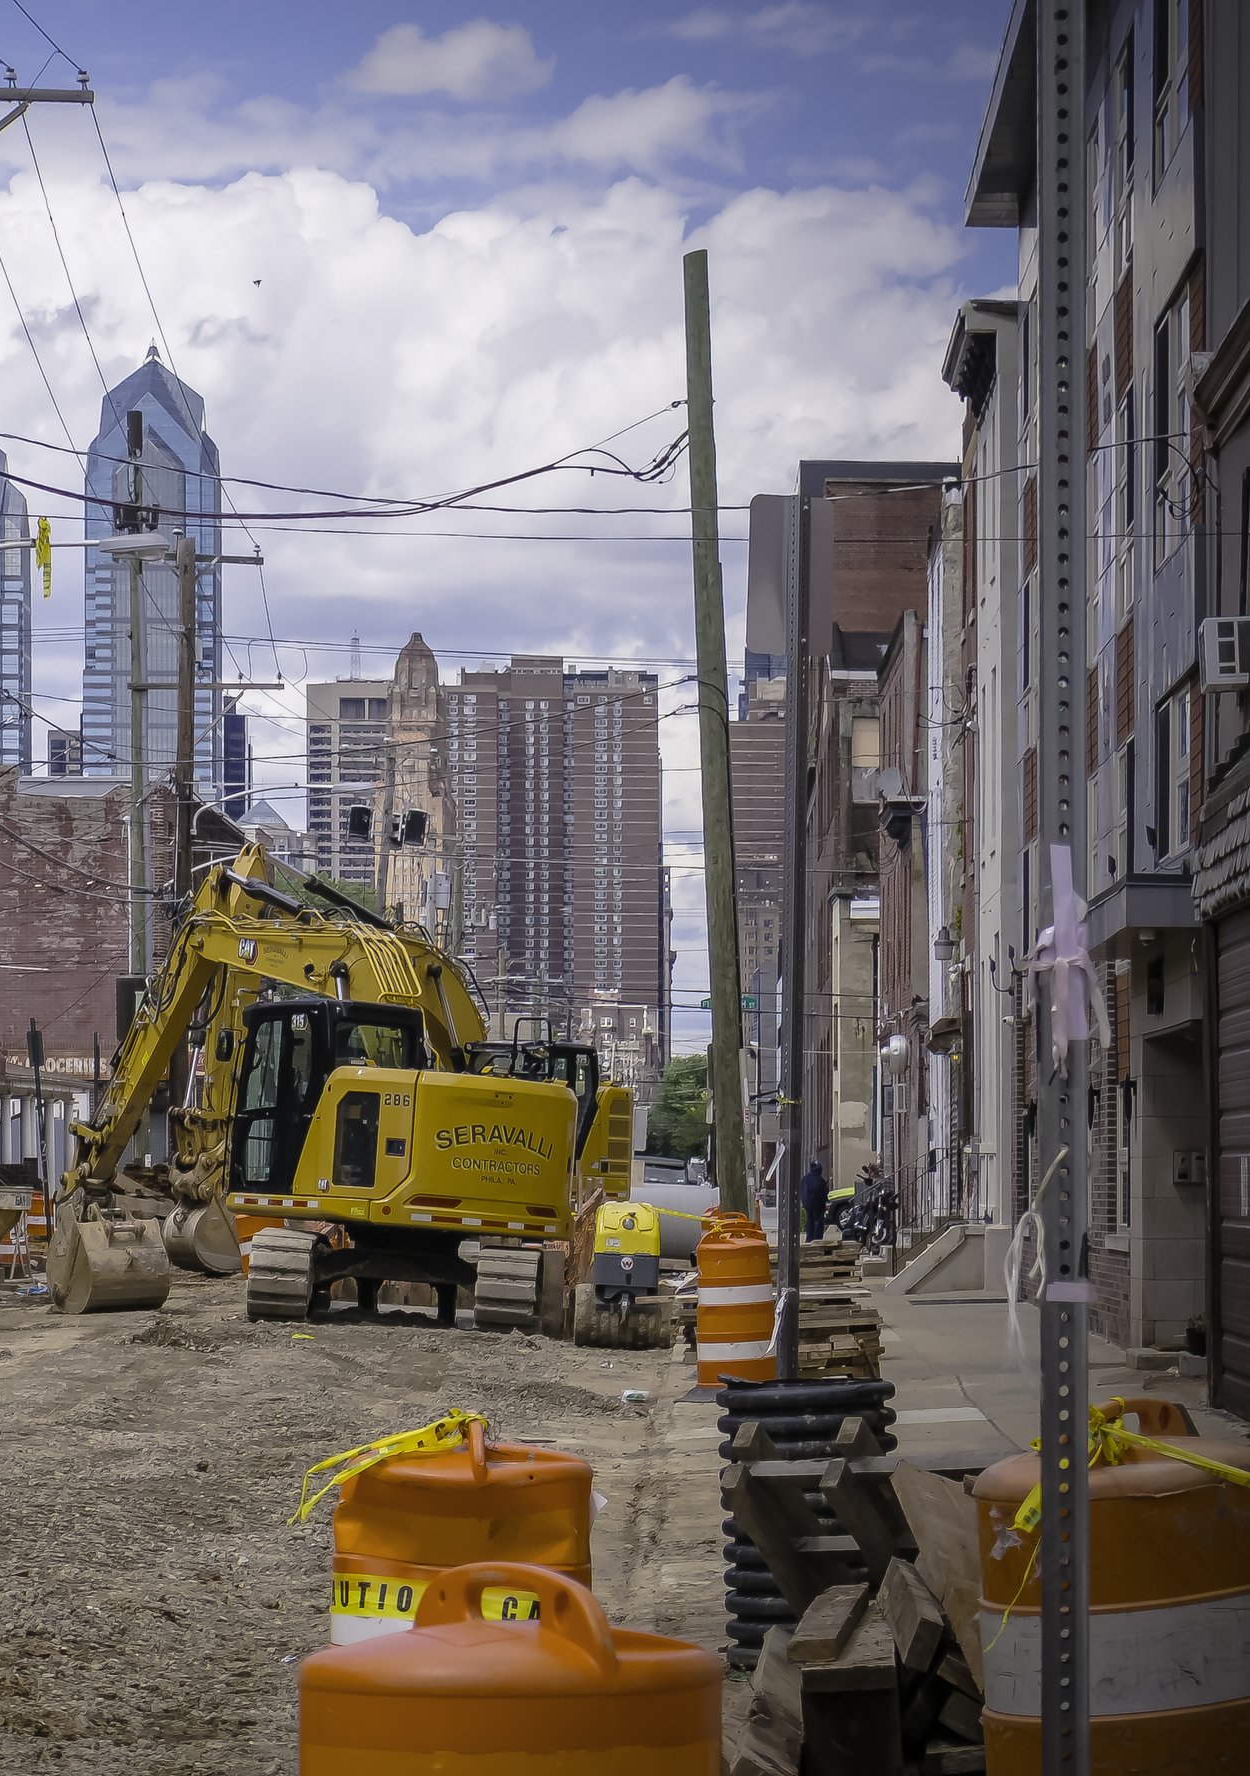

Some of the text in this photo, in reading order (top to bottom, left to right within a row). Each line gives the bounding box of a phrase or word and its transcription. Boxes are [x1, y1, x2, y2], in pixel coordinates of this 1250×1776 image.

[238, 938, 255, 960] CAT
[291, 1013, 304, 1028] 315
[435, 1123, 554, 1161] SERAVALLI
[451, 1156, 541, 1177] CONTRACTORS
